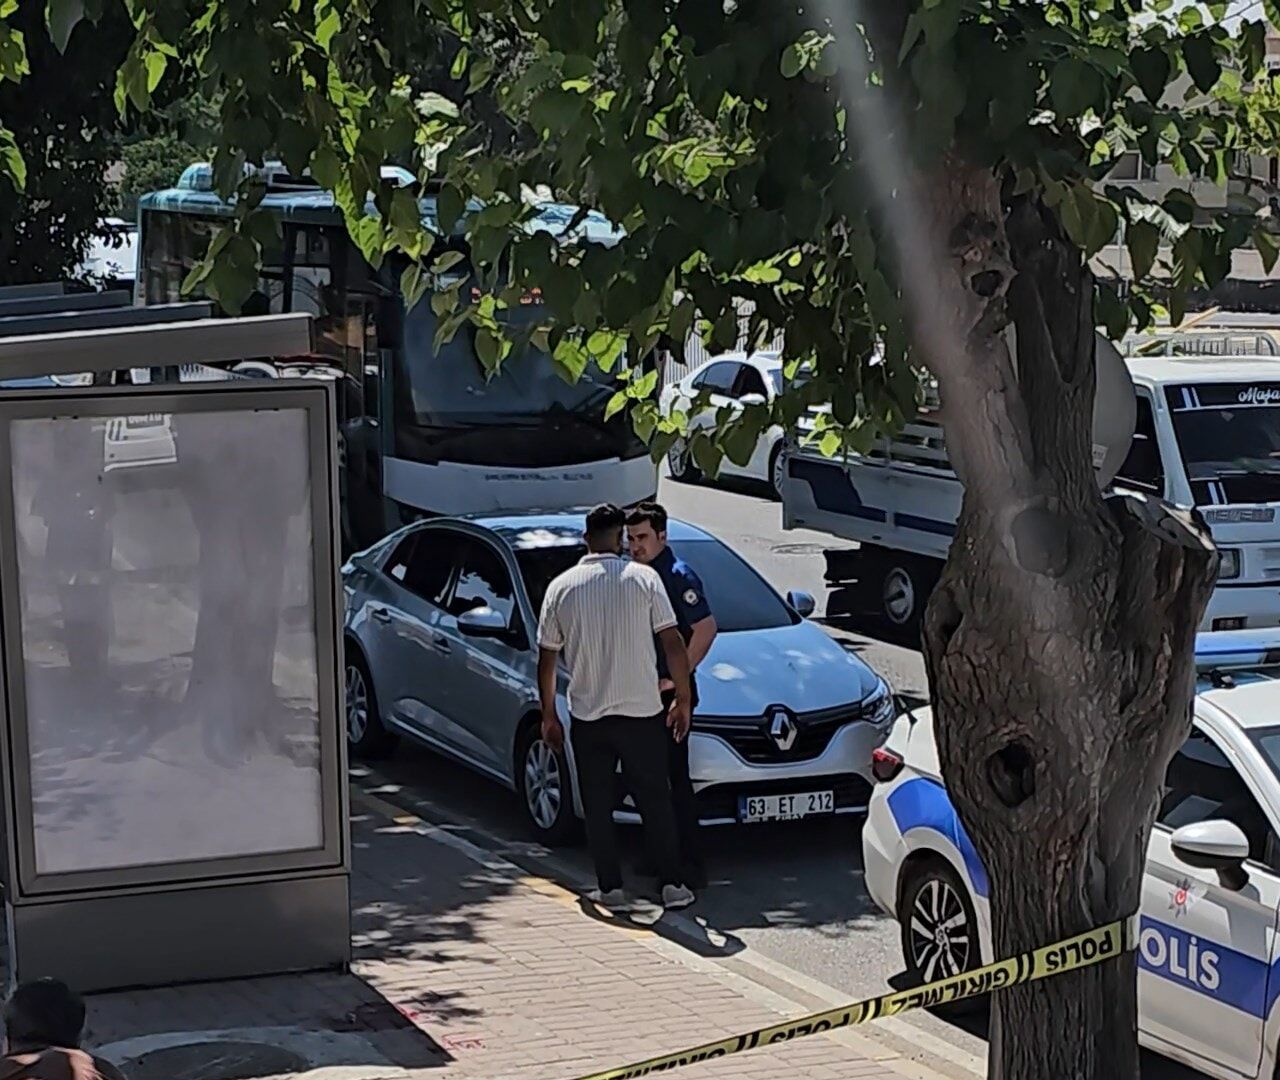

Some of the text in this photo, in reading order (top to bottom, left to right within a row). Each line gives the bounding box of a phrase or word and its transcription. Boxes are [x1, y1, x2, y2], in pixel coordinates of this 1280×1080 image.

[748, 793, 832, 816] 63 ET 212
[1140, 927, 1220, 990] OLİS
